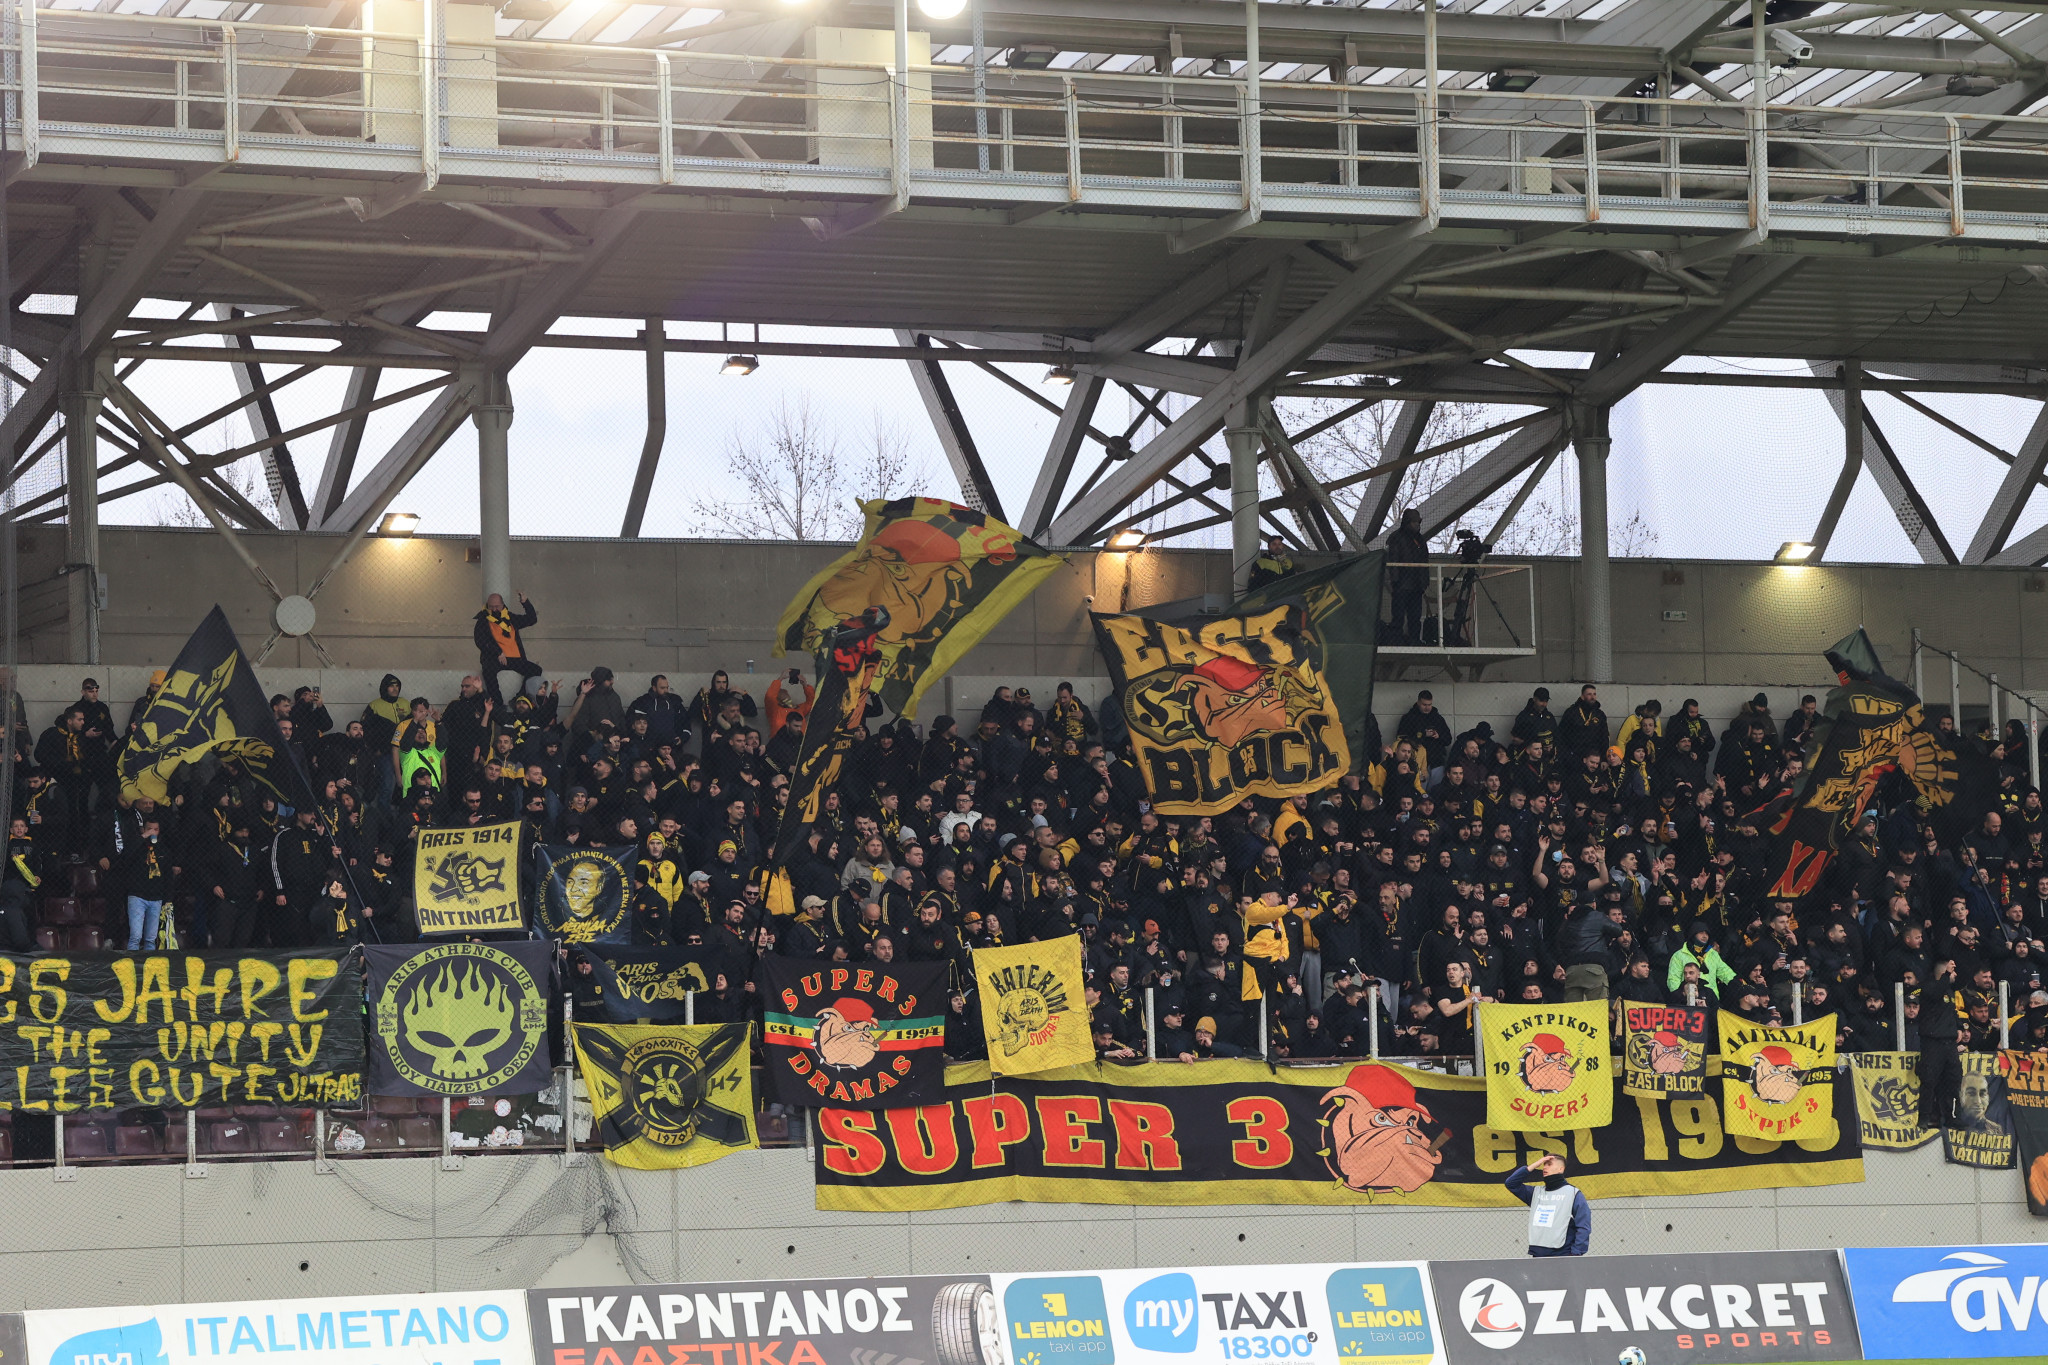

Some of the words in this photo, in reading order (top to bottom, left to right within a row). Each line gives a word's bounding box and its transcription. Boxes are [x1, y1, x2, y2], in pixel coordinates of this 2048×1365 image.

[1101, 604, 1298, 680] EAST
[1144, 713, 1341, 803] BLOCK
[421, 832, 465, 849] ARIS
[472, 827, 513, 843] 1914
[419, 901, 519, 926] ANTINAZI
[387, 960, 418, 994] ARIS
[424, 944, 496, 962] ATHENS
[501, 956, 534, 990] CLUB
[93, 956, 338, 1024] JAHRE
[781, 968, 898, 1012] SUPER
[898, 994, 917, 1016] 3
[17, 1025, 111, 1065] THE
[158, 1021, 323, 1066] UNITY
[769, 1024, 802, 1037] est.
[895, 1025, 940, 1040] 1994
[1501, 1013, 1598, 1042] ΚΕΝΤΡΙΚΟΣ
[390, 1045, 421, 1081] ΟΠΟΥ
[425, 1077, 481, 1093] ΠΑΙΖΕΙ
[502, 1042, 535, 1076] ΘΕΟΣ
[788, 1051, 912, 1101] DRAMAS
[1899, 1053, 1921, 1070] 191
[0, 1065, 115, 1111] LES
[129, 1059, 277, 1106] GUTE
[1626, 1072, 1658, 1091] EAST
[1664, 1075, 1704, 1093] BLOCK
[1510, 1097, 1579, 1119] SUPER
[1634, 1093, 1840, 1160] 19
[657, 1131, 686, 1144] 1970
[819, 1092, 1182, 1176] SUPER
[1226, 1096, 1293, 1169] 3
[1968, 1131, 2012, 1148] ΠΑΝΤΑ
[1980, 1150, 2010, 1166] ΜΑΣ
[547, 1287, 914, 1344] ΓΚΑΡΝΤΑΝΟΣ
[1135, 1297, 1194, 1337] my
[1202, 1290, 1308, 1330] TAXI
[1336, 1309, 1423, 1328] LEMON
[1526, 1281, 1828, 1335] ZAKCRET
[1950, 1276, 2048, 1333] av
[185, 1303, 510, 1356] ITALMETANO
[1014, 1319, 1104, 1339] LEMON
[1048, 1340, 1075, 1353] taxi
[1078, 1340, 1106, 1353] app
[1219, 1334, 1312, 1359] 18300
[1370, 1329, 1395, 1342] taxi
[1398, 1329, 1426, 1343] app
[1677, 1329, 1832, 1350] SPORTS
